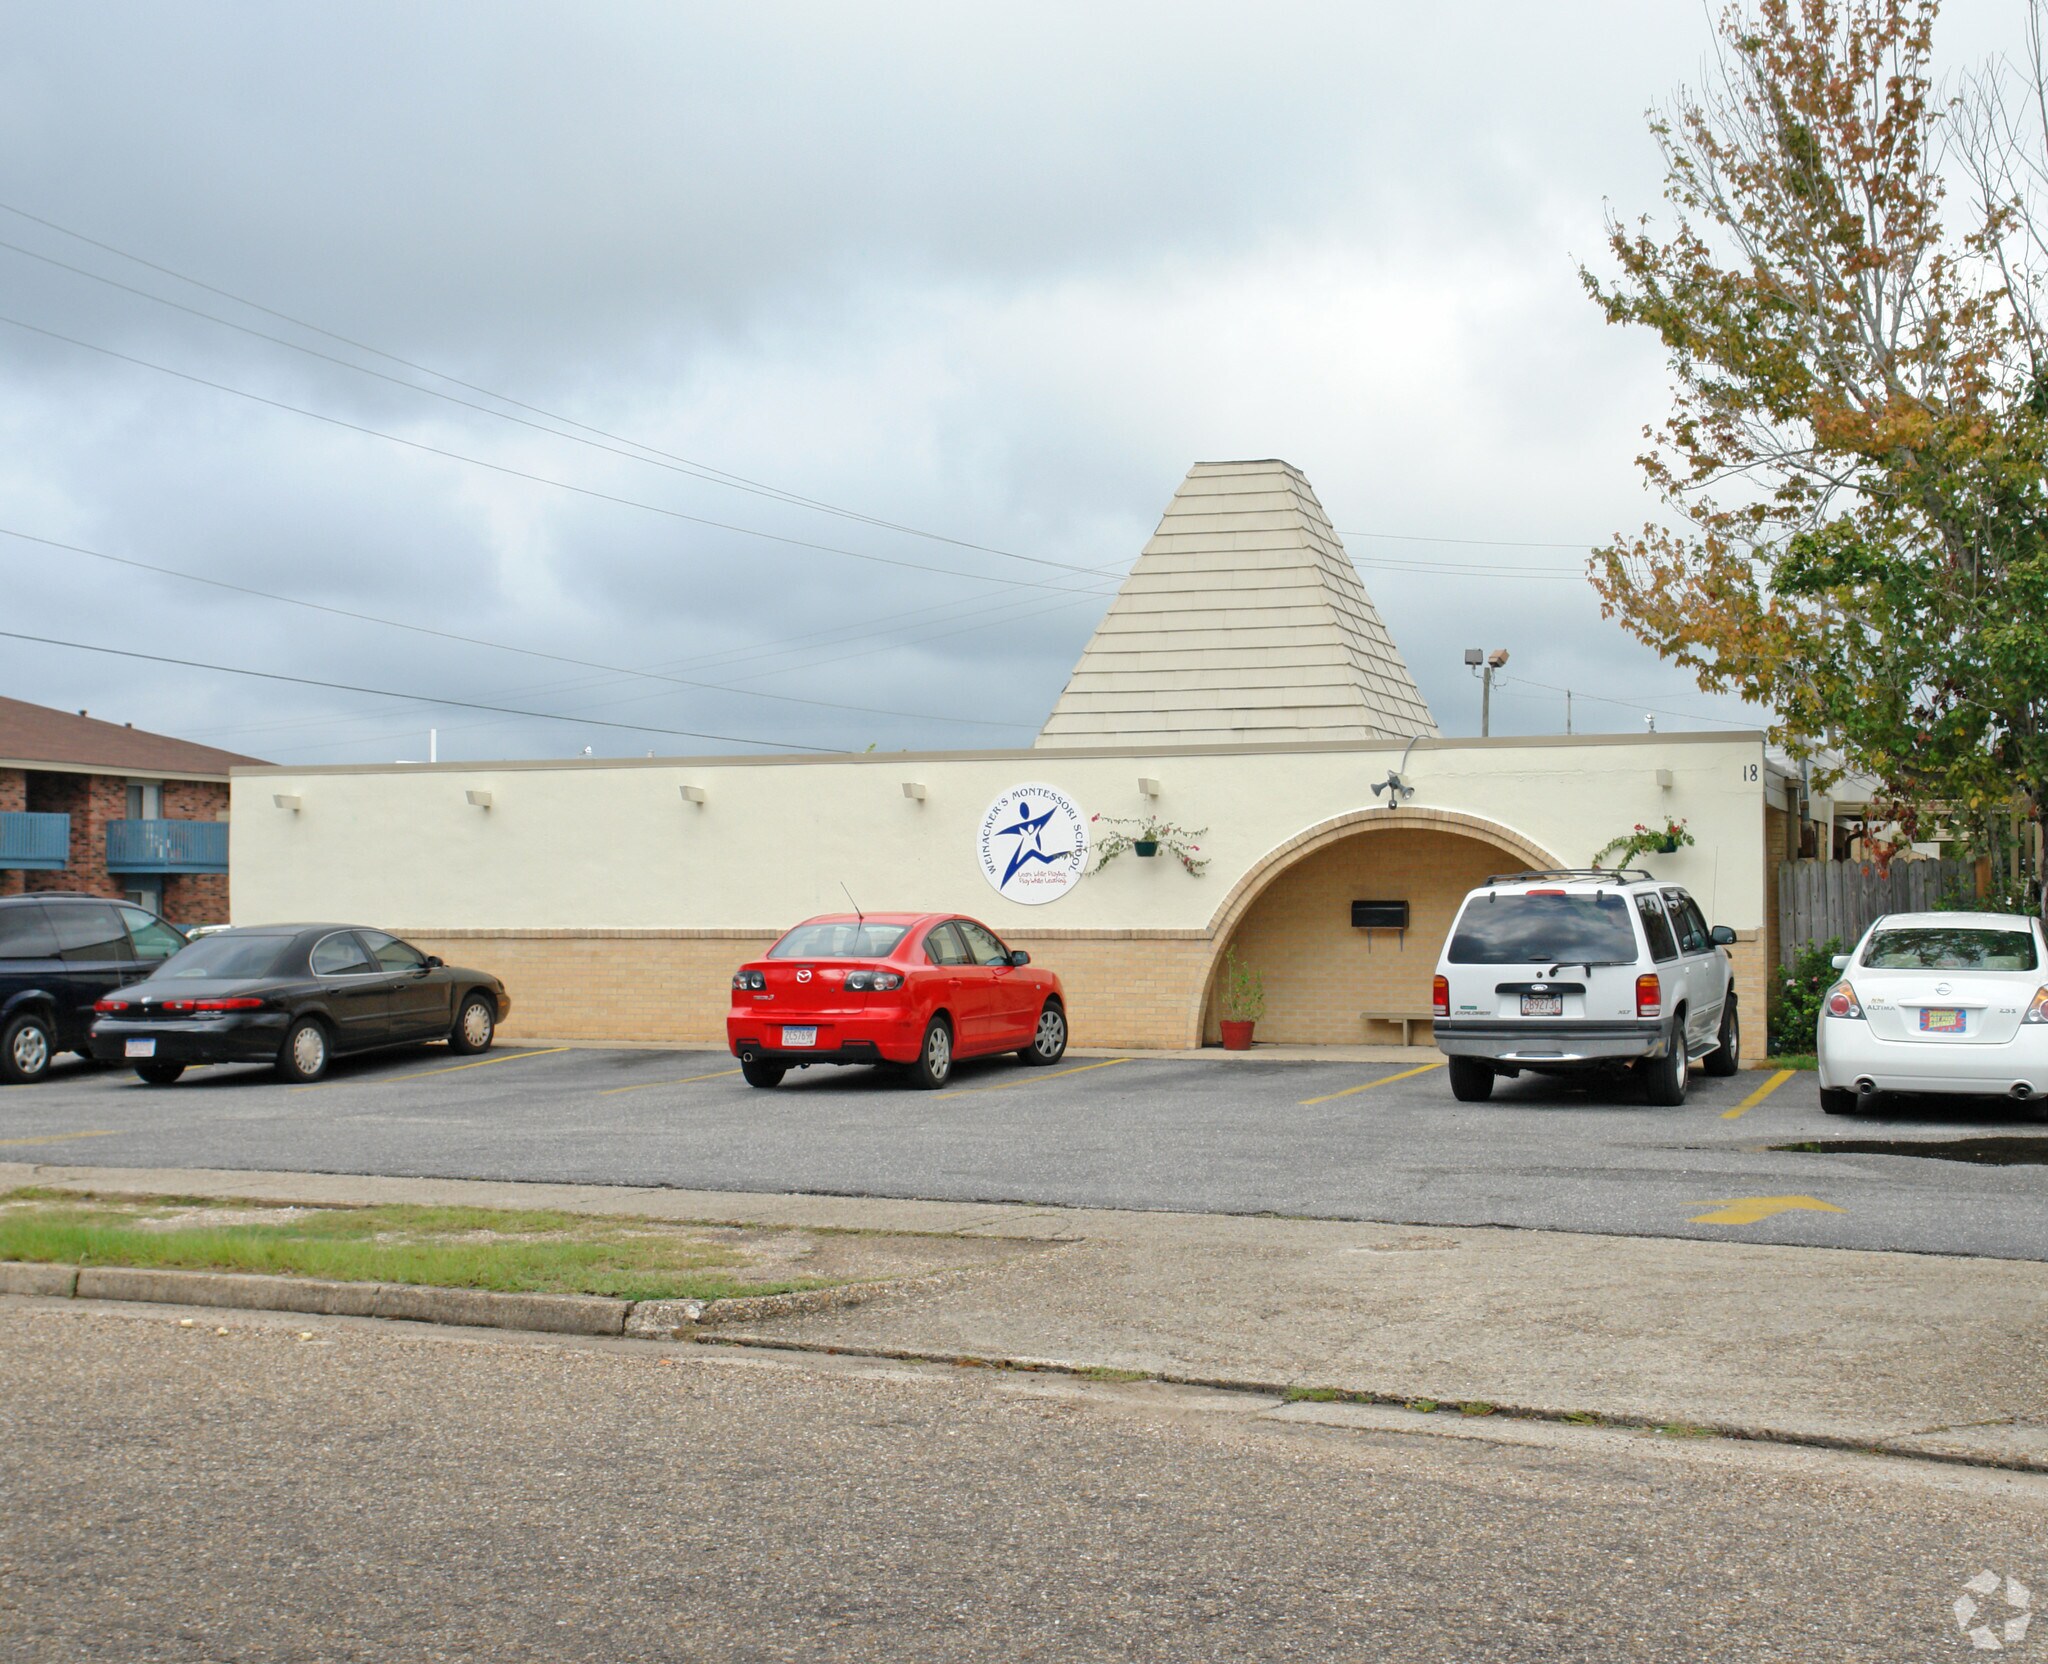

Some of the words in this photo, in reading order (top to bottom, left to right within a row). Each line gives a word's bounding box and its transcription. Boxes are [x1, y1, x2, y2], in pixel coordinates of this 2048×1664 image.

[1743, 763, 1758, 782] 18
[982, 797, 1009, 875] WEINACKER'S
[1012, 787, 1077, 821] MONTESSORI
[1068, 824, 1084, 871] SCHOOL
